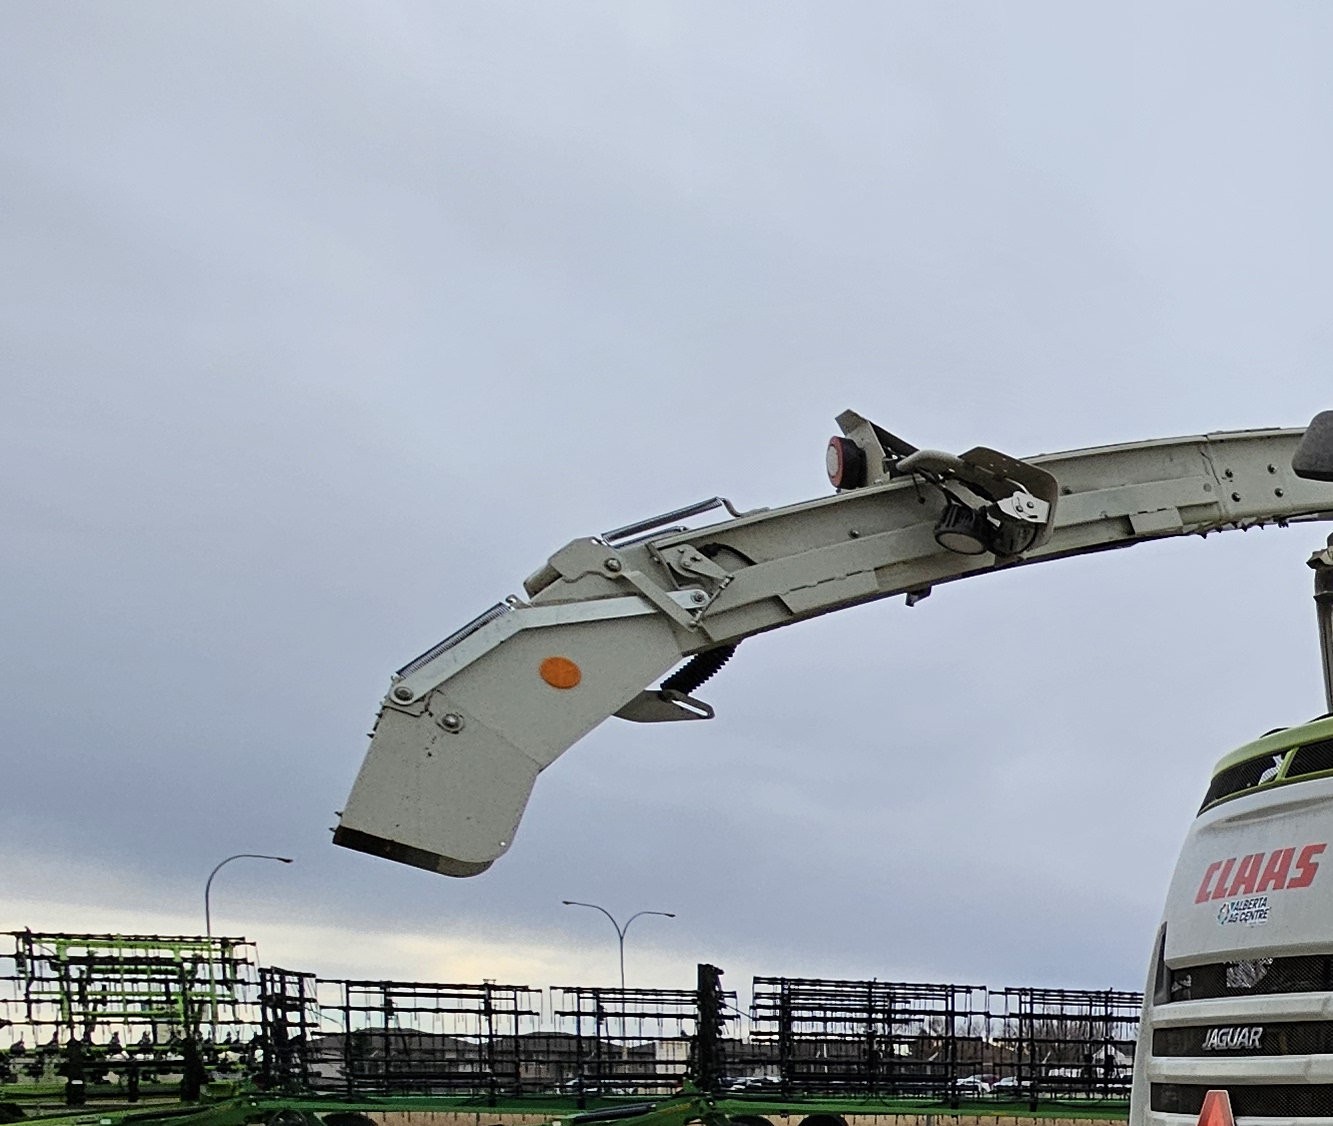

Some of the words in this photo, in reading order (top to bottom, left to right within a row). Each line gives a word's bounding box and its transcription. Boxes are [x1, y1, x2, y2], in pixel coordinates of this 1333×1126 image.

[1194, 843, 1328, 904] CLAAS
[1234, 897, 1268, 911] ALBERTA
[1228, 912, 1239, 923] AG
[1239, 909, 1268, 922] CENTRE
[1202, 1026, 1263, 1050] JAGUAR
